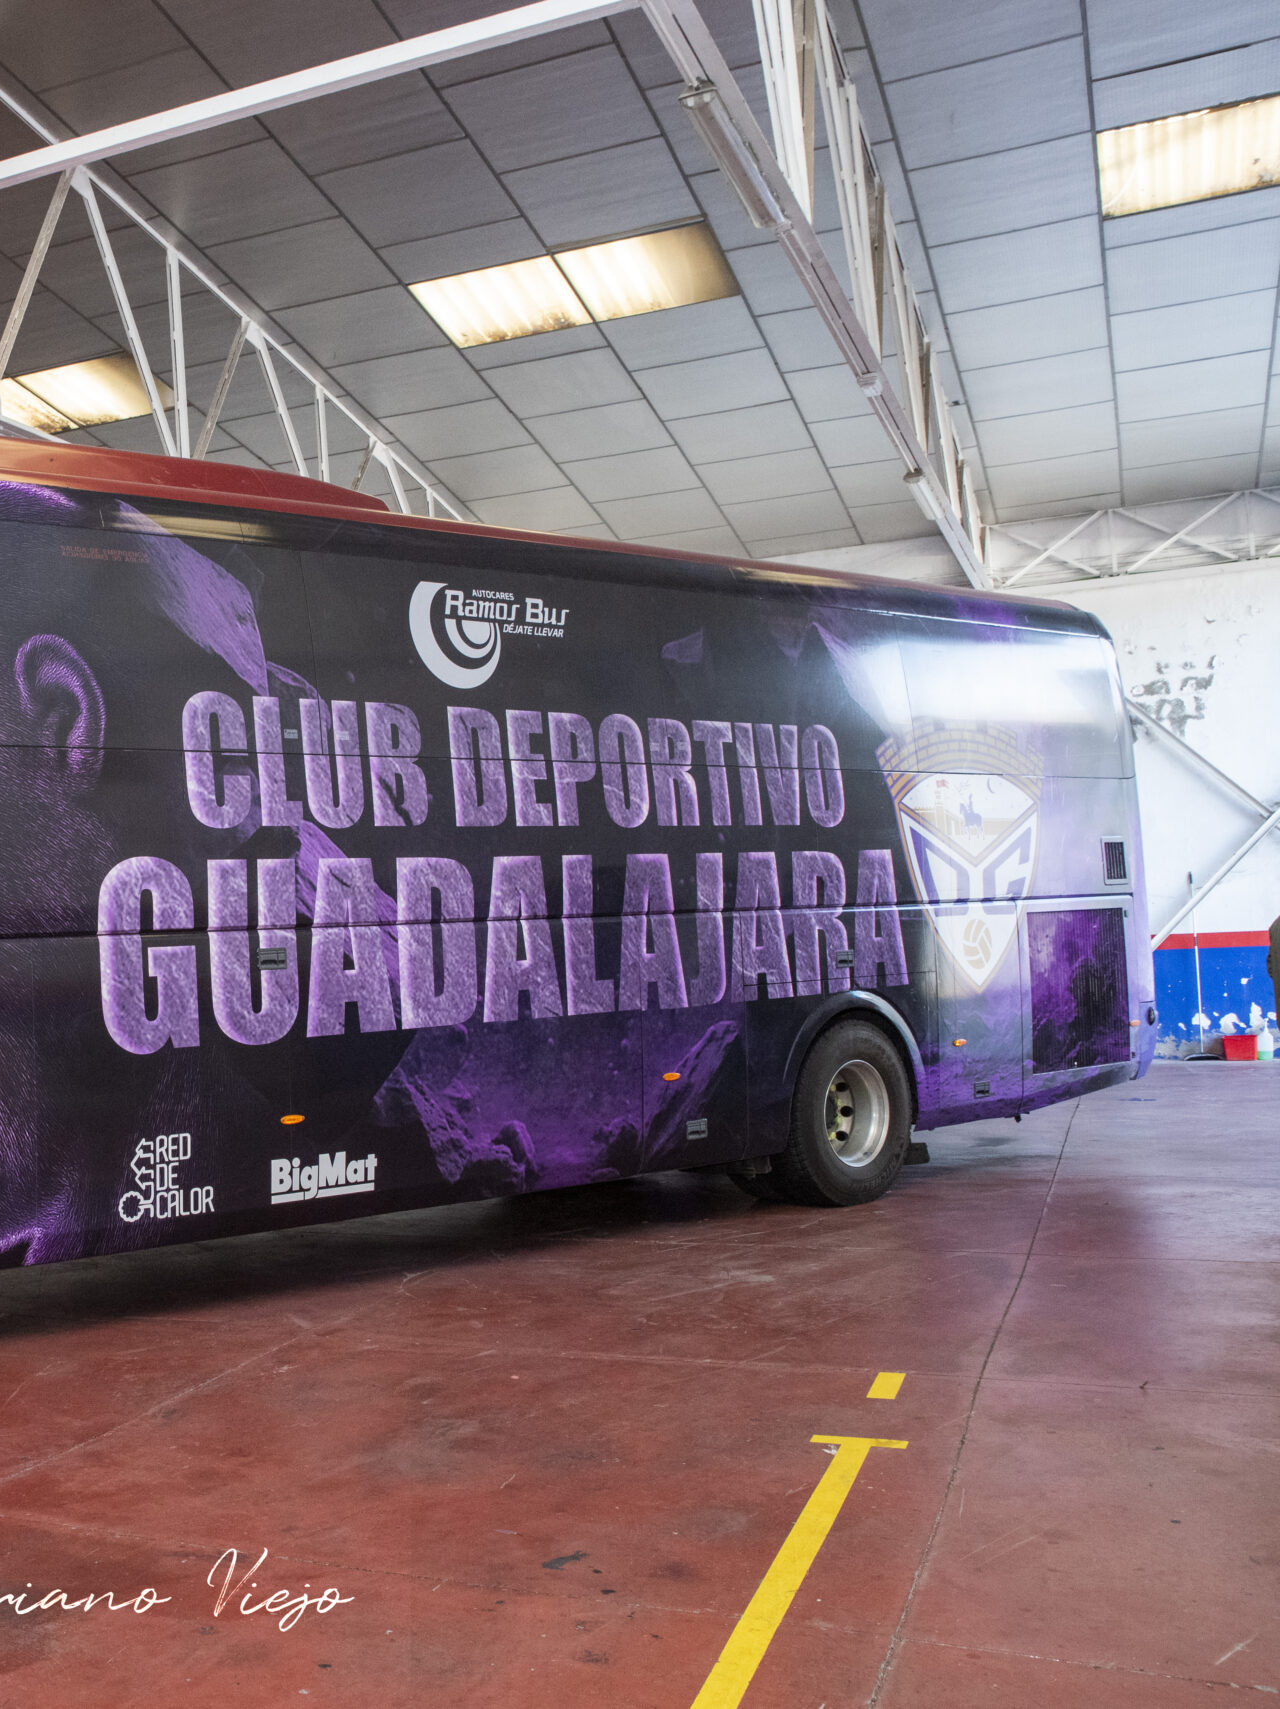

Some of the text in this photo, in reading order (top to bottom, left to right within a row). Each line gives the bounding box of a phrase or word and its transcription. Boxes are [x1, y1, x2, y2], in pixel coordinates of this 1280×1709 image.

[444, 590, 570, 626] Ramos Bus
[472, 589, 515, 601] AUTOCARES
[503, 622, 564, 638] DÉJATE LLEVAR
[182, 691, 845, 829] CLUB DEPORTIVO
[98, 849, 910, 1056] GUADALAJARA
[155, 1133, 192, 1163] RED
[155, 1162, 180, 1191] DE
[271, 1151, 377, 1200] BigMat
[156, 1185, 215, 1219] CALOR
